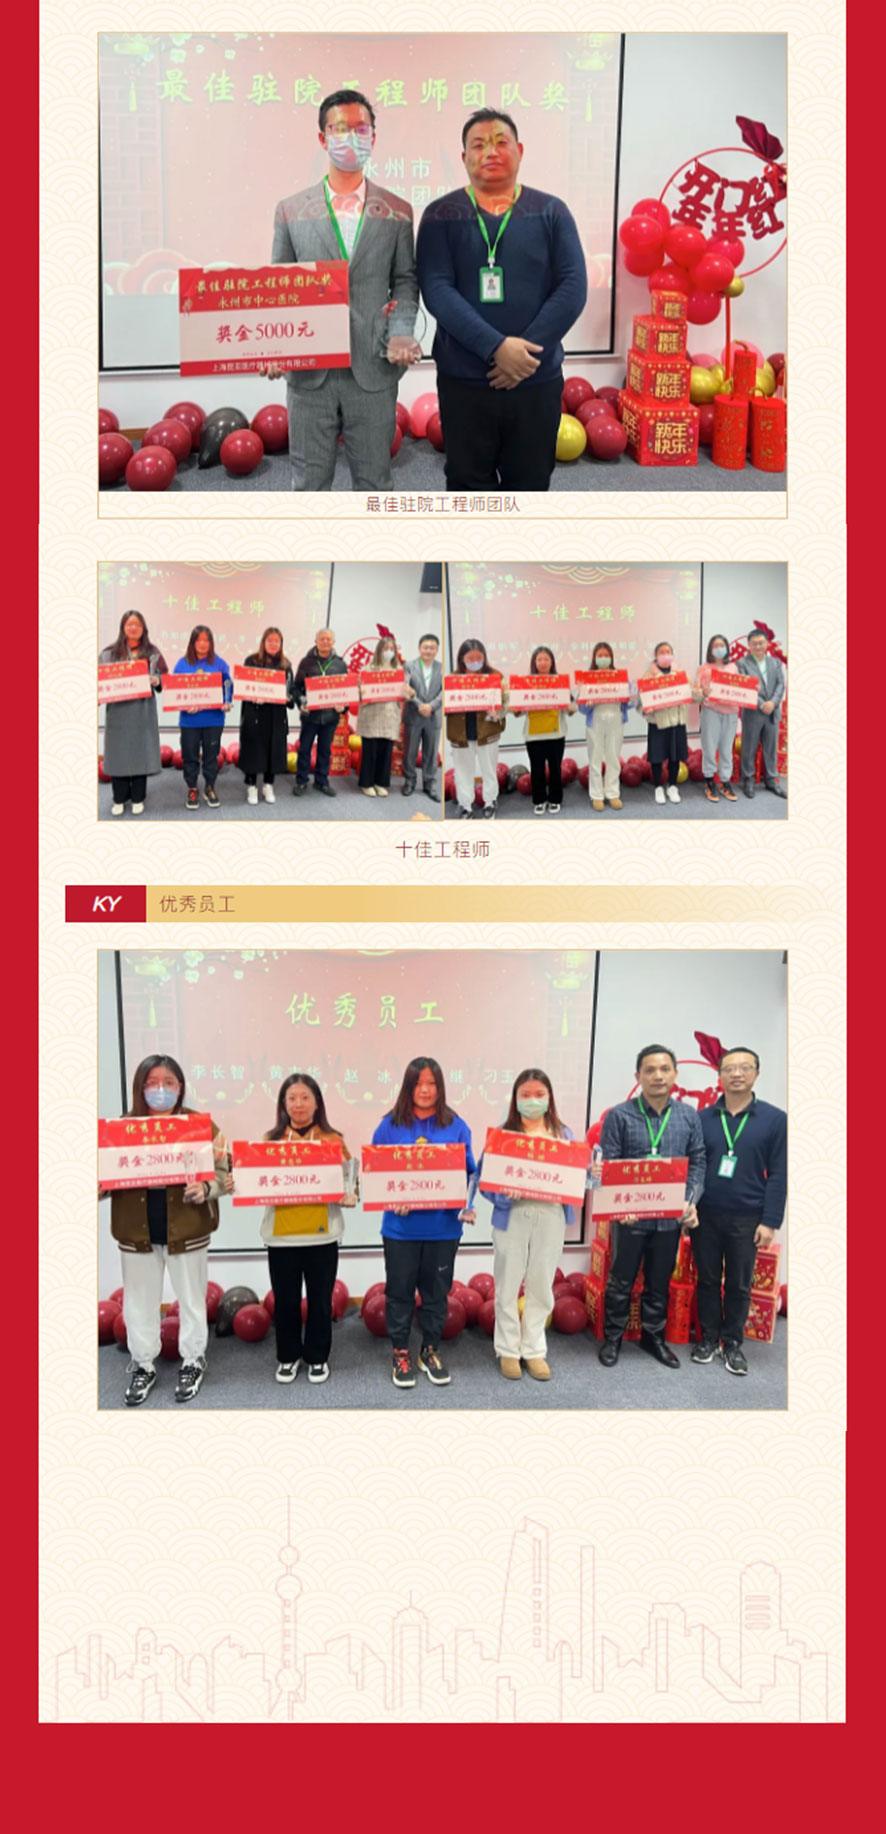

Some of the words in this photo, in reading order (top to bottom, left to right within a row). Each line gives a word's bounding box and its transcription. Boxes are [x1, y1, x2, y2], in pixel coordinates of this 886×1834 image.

[216, 321, 315, 343] 奖金5000元
[656, 421, 688, 437] 新年
[655, 438, 688, 454] 快乐
[285, 992, 445, 1028] 优秀员工
